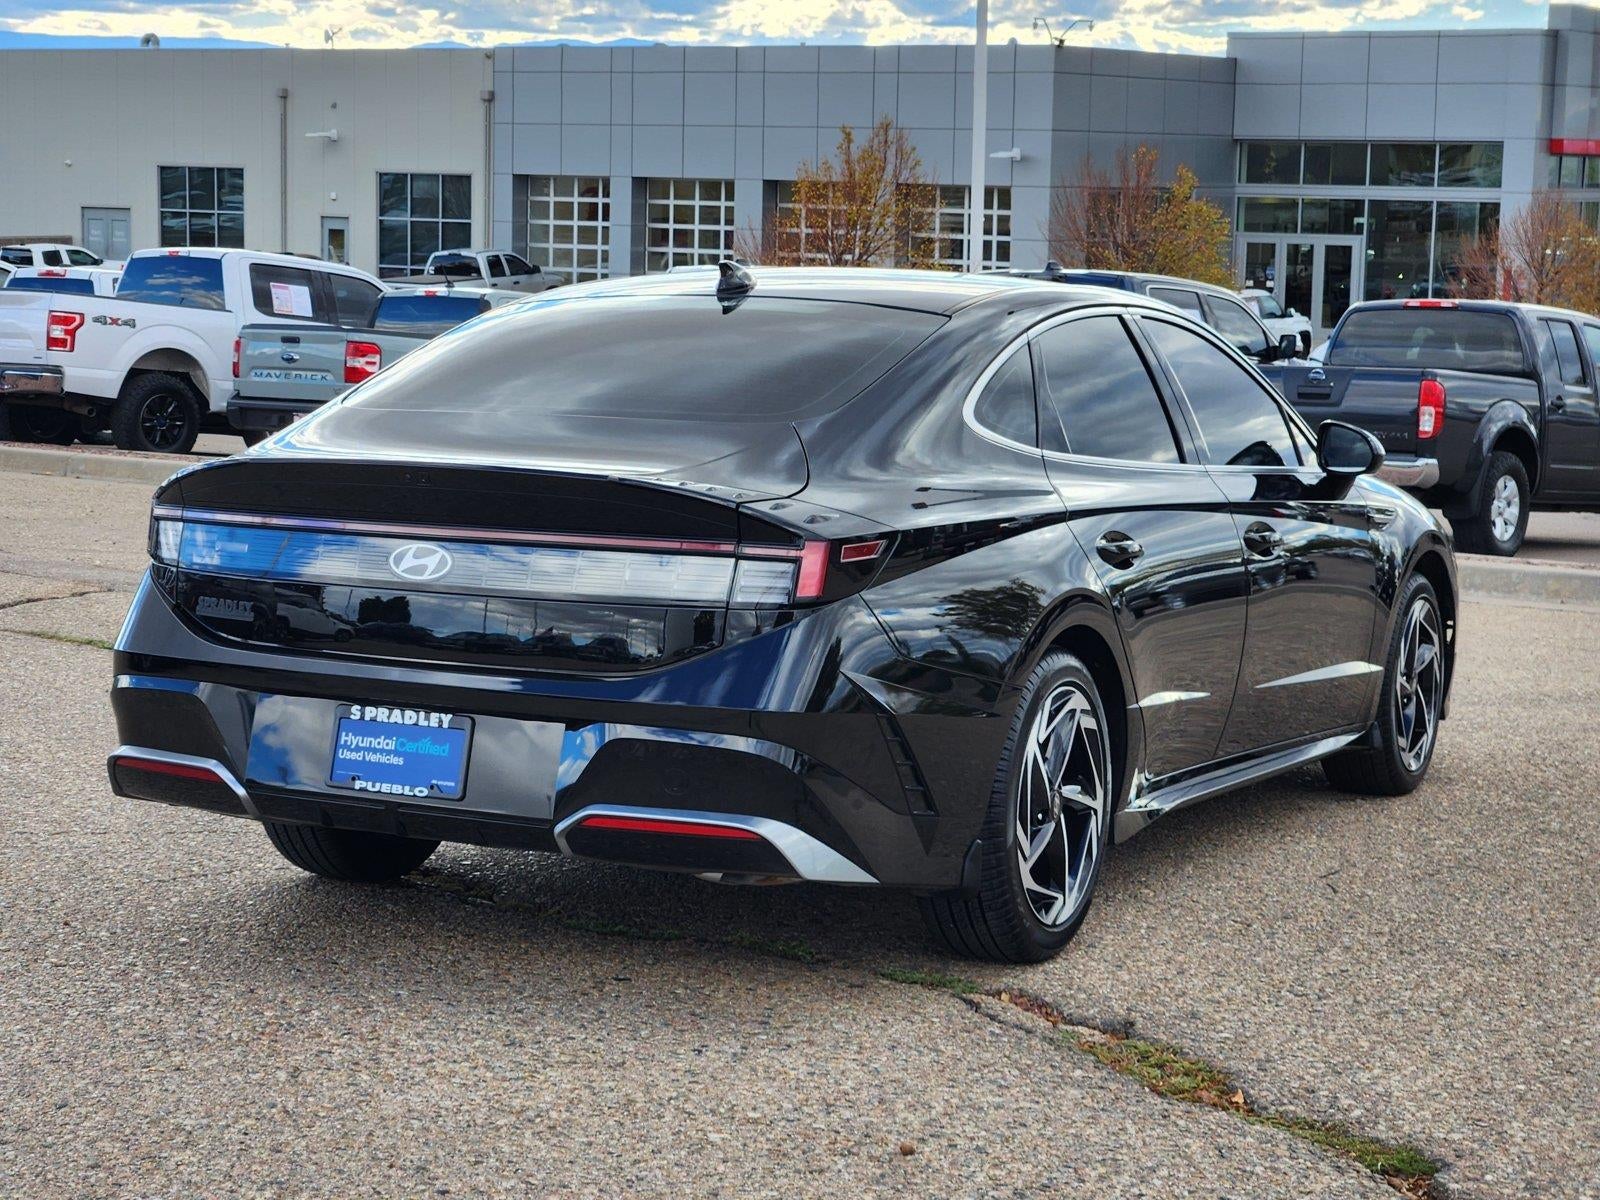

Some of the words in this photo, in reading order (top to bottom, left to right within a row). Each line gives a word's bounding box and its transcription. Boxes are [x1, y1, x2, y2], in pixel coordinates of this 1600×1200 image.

[253, 371, 328, 382] MAVERICK
[341, 732, 396, 750] Hyundai
[396, 736, 449, 756] Certified
[338, 749, 363, 760] Used
[364, 751, 404, 765] Vehicles
[354, 780, 428, 796] PUEBLO
